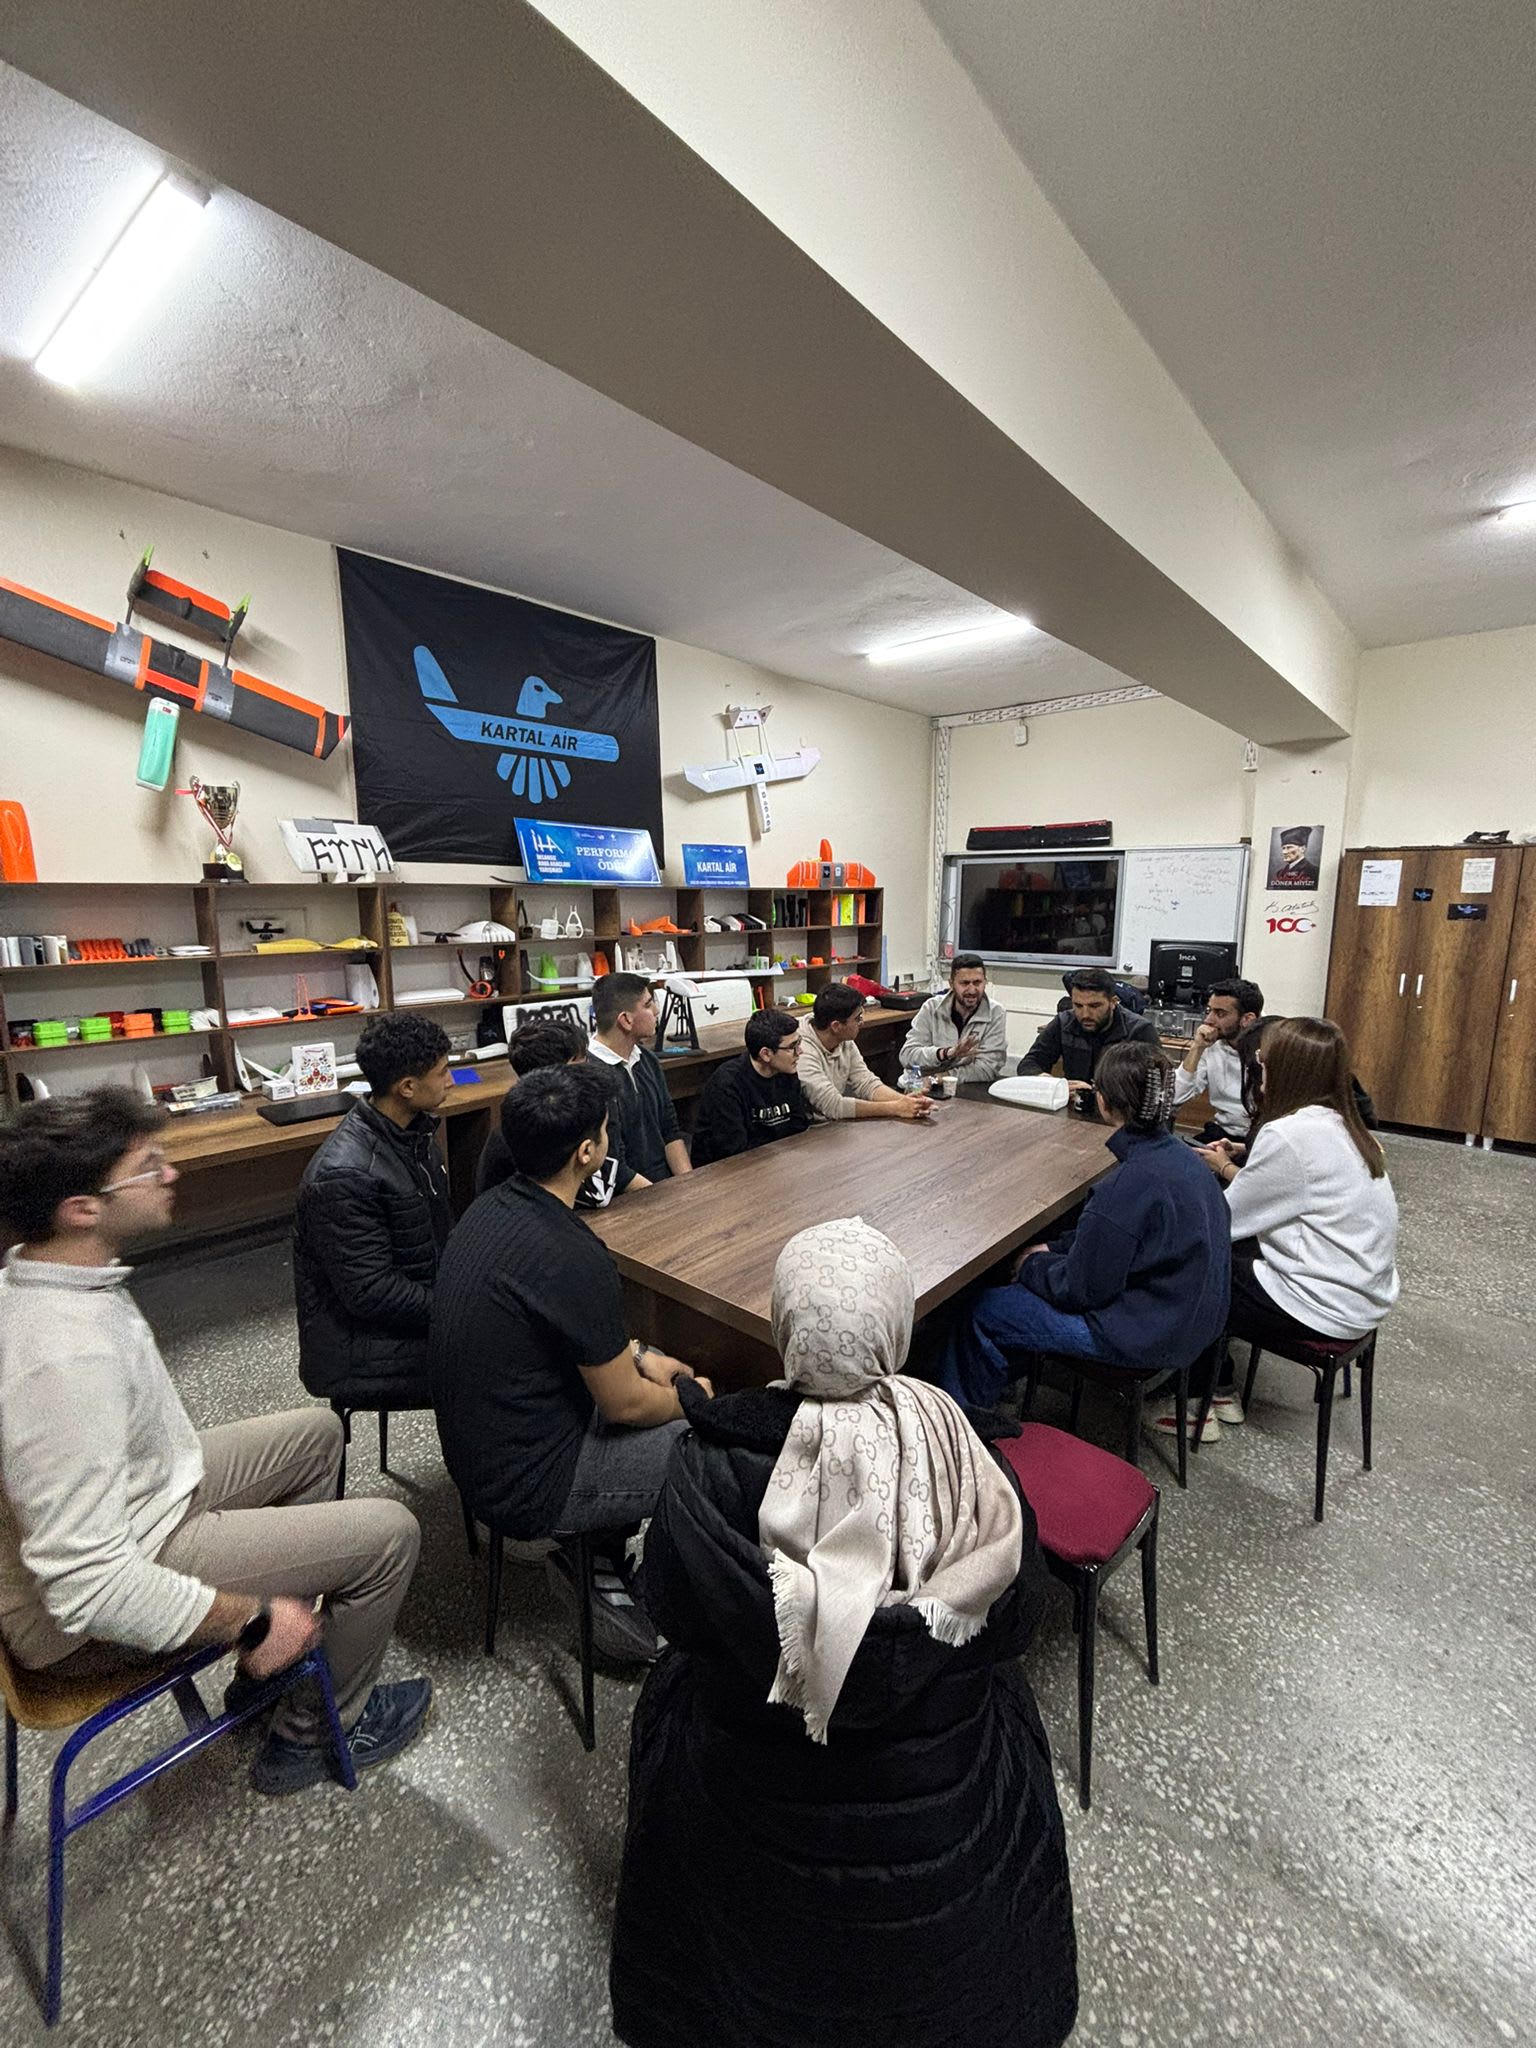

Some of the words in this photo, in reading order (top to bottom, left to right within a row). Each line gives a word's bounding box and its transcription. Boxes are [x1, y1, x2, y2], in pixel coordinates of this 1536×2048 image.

[481, 721, 546, 746] KARTAL
[575, 846, 649, 859] PERFORM
[696, 861, 724, 873] KARTAL
